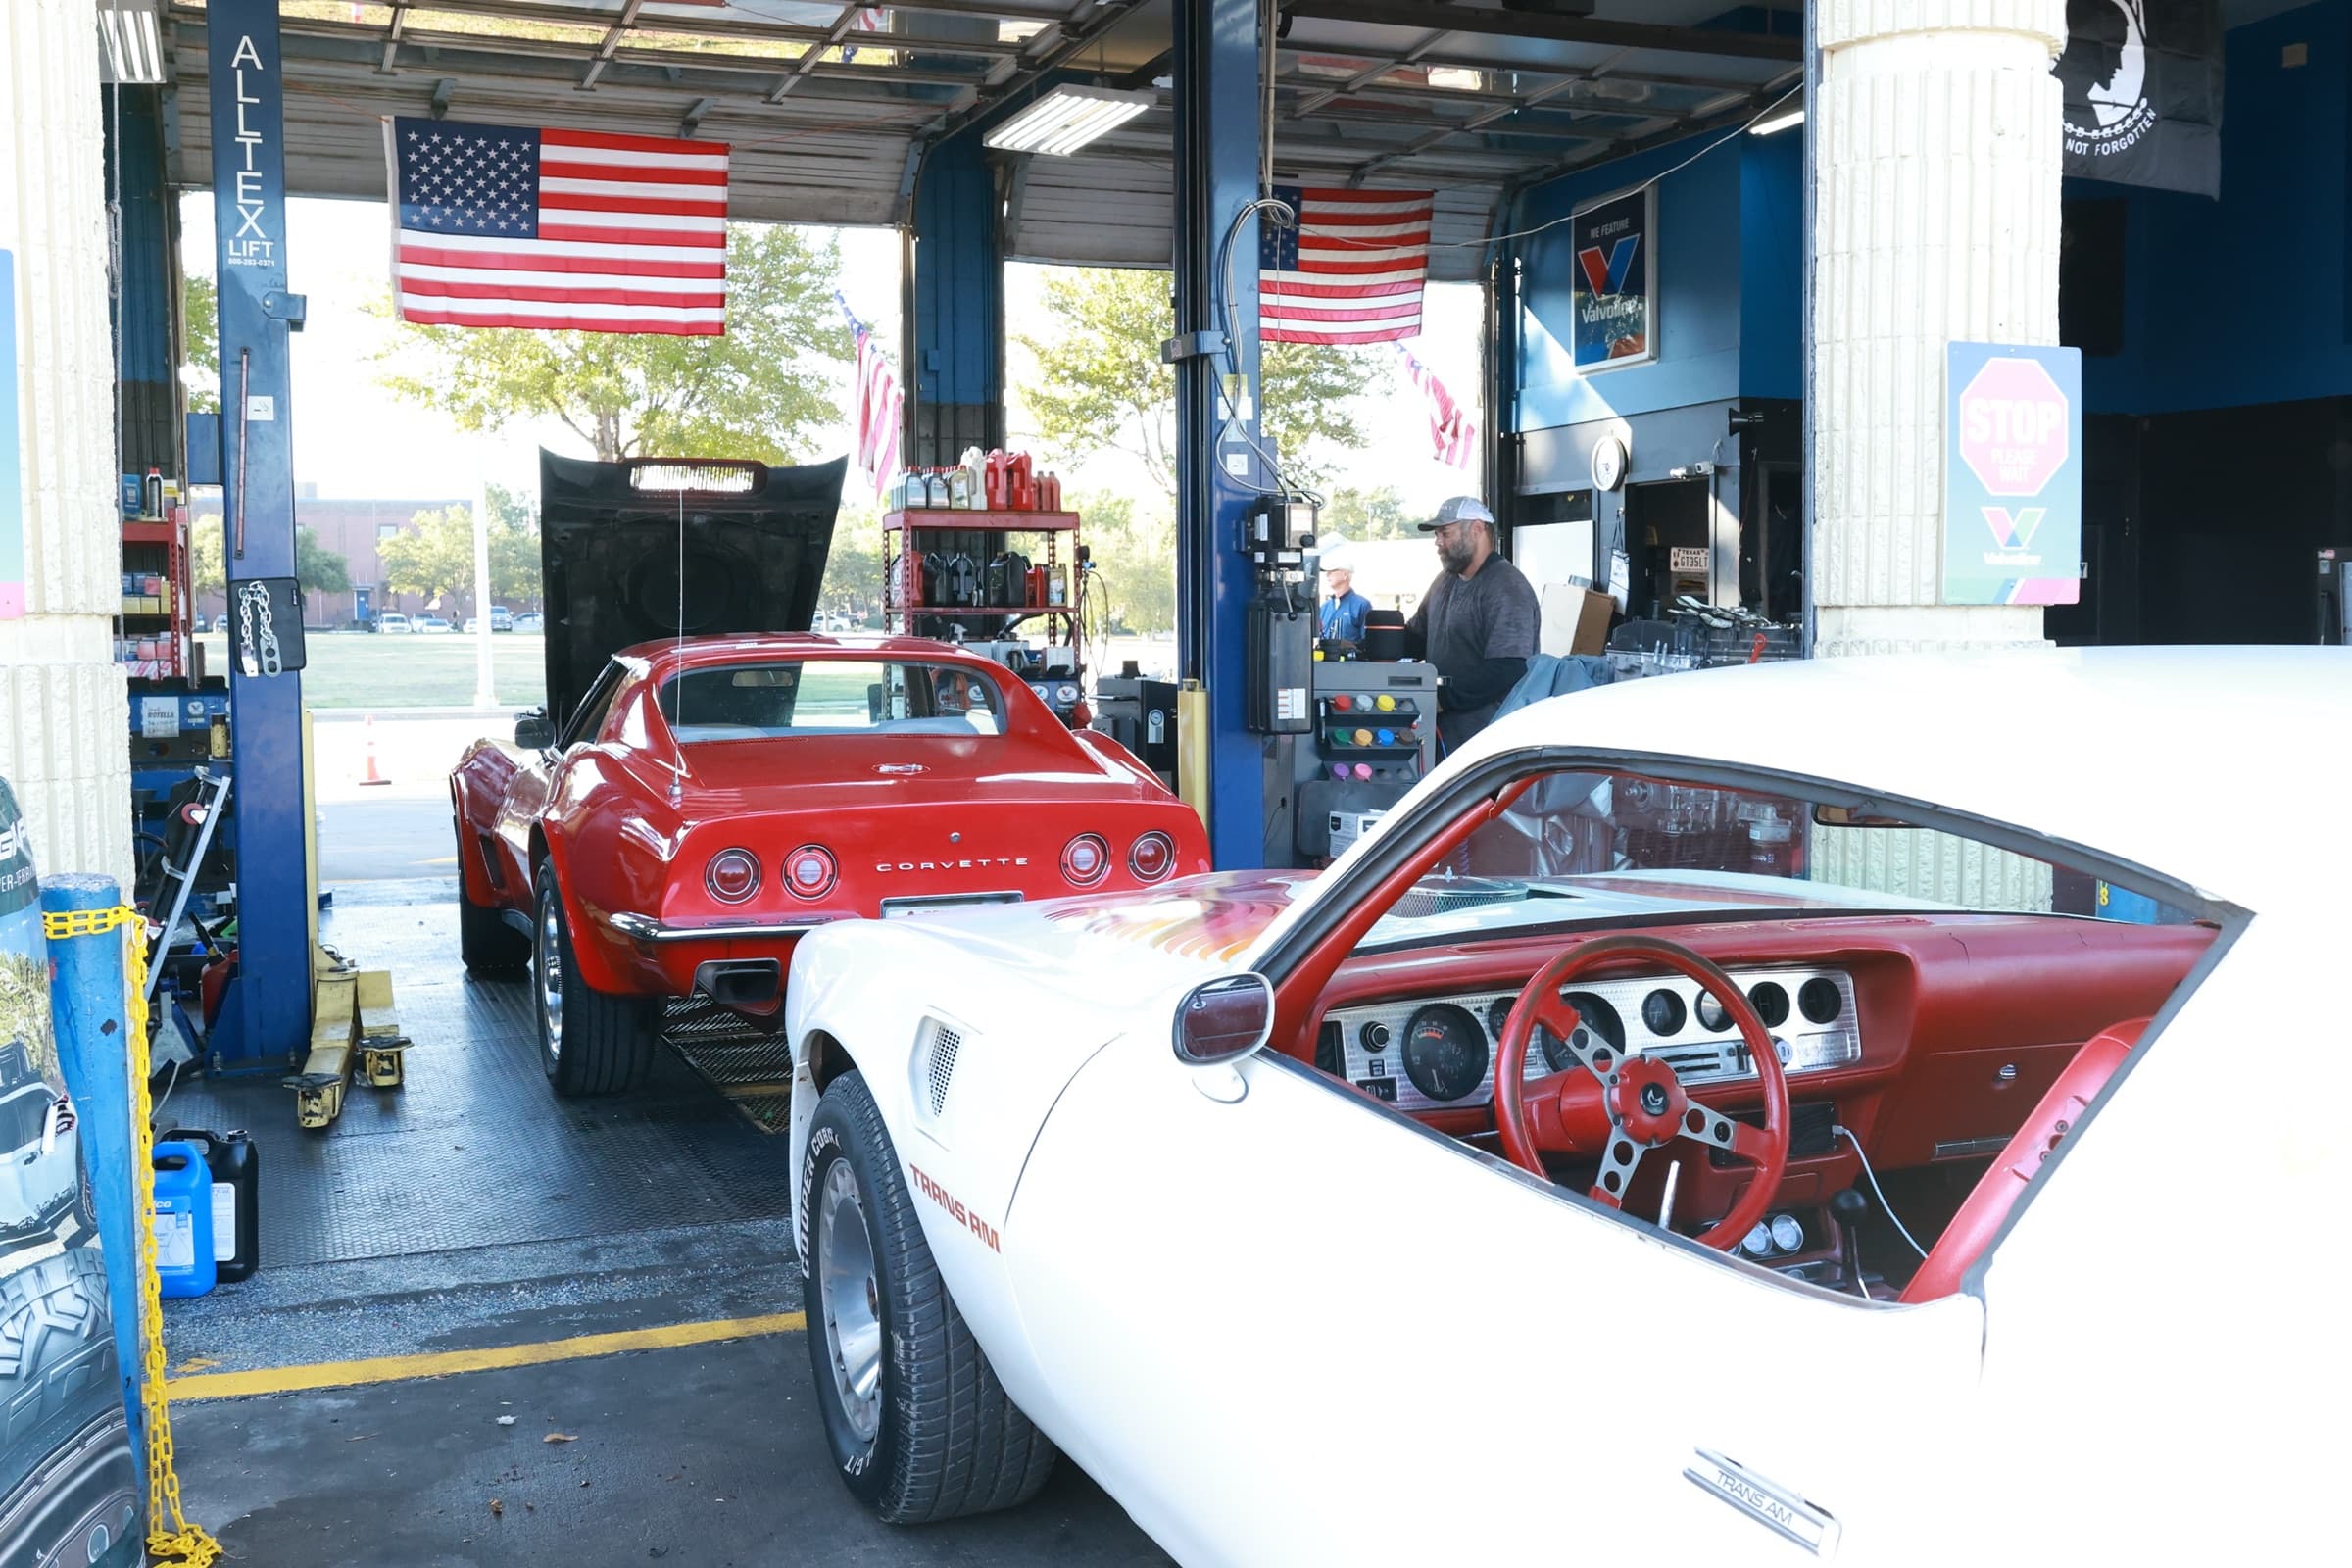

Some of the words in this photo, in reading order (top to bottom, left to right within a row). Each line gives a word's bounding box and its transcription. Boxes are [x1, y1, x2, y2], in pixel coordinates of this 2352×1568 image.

[230, 35, 267, 239] ALLTEX
[2065, 138, 2089, 156] NOT
[2094, 108, 2156, 156] FORGOTTEN
[228, 239, 274, 258] LIFT
[1590, 226, 1600, 239] WE
[1600, 218, 1630, 237] FEATURE
[1967, 398, 2062, 445] STOP
[1990, 447, 2039, 465] PLEASE
[1999, 465, 2033, 483] WAIT
[876, 858, 1028, 872] CORVETTE
[801, 1152, 815, 1280] COOPER
[811, 1126, 842, 1157] COBRA
[909, 1162, 967, 1227] TRANS
[968, 1209, 1001, 1254] AM
[1717, 1470, 1766, 1508] TRANS
[1765, 1502, 1792, 1526] AM
